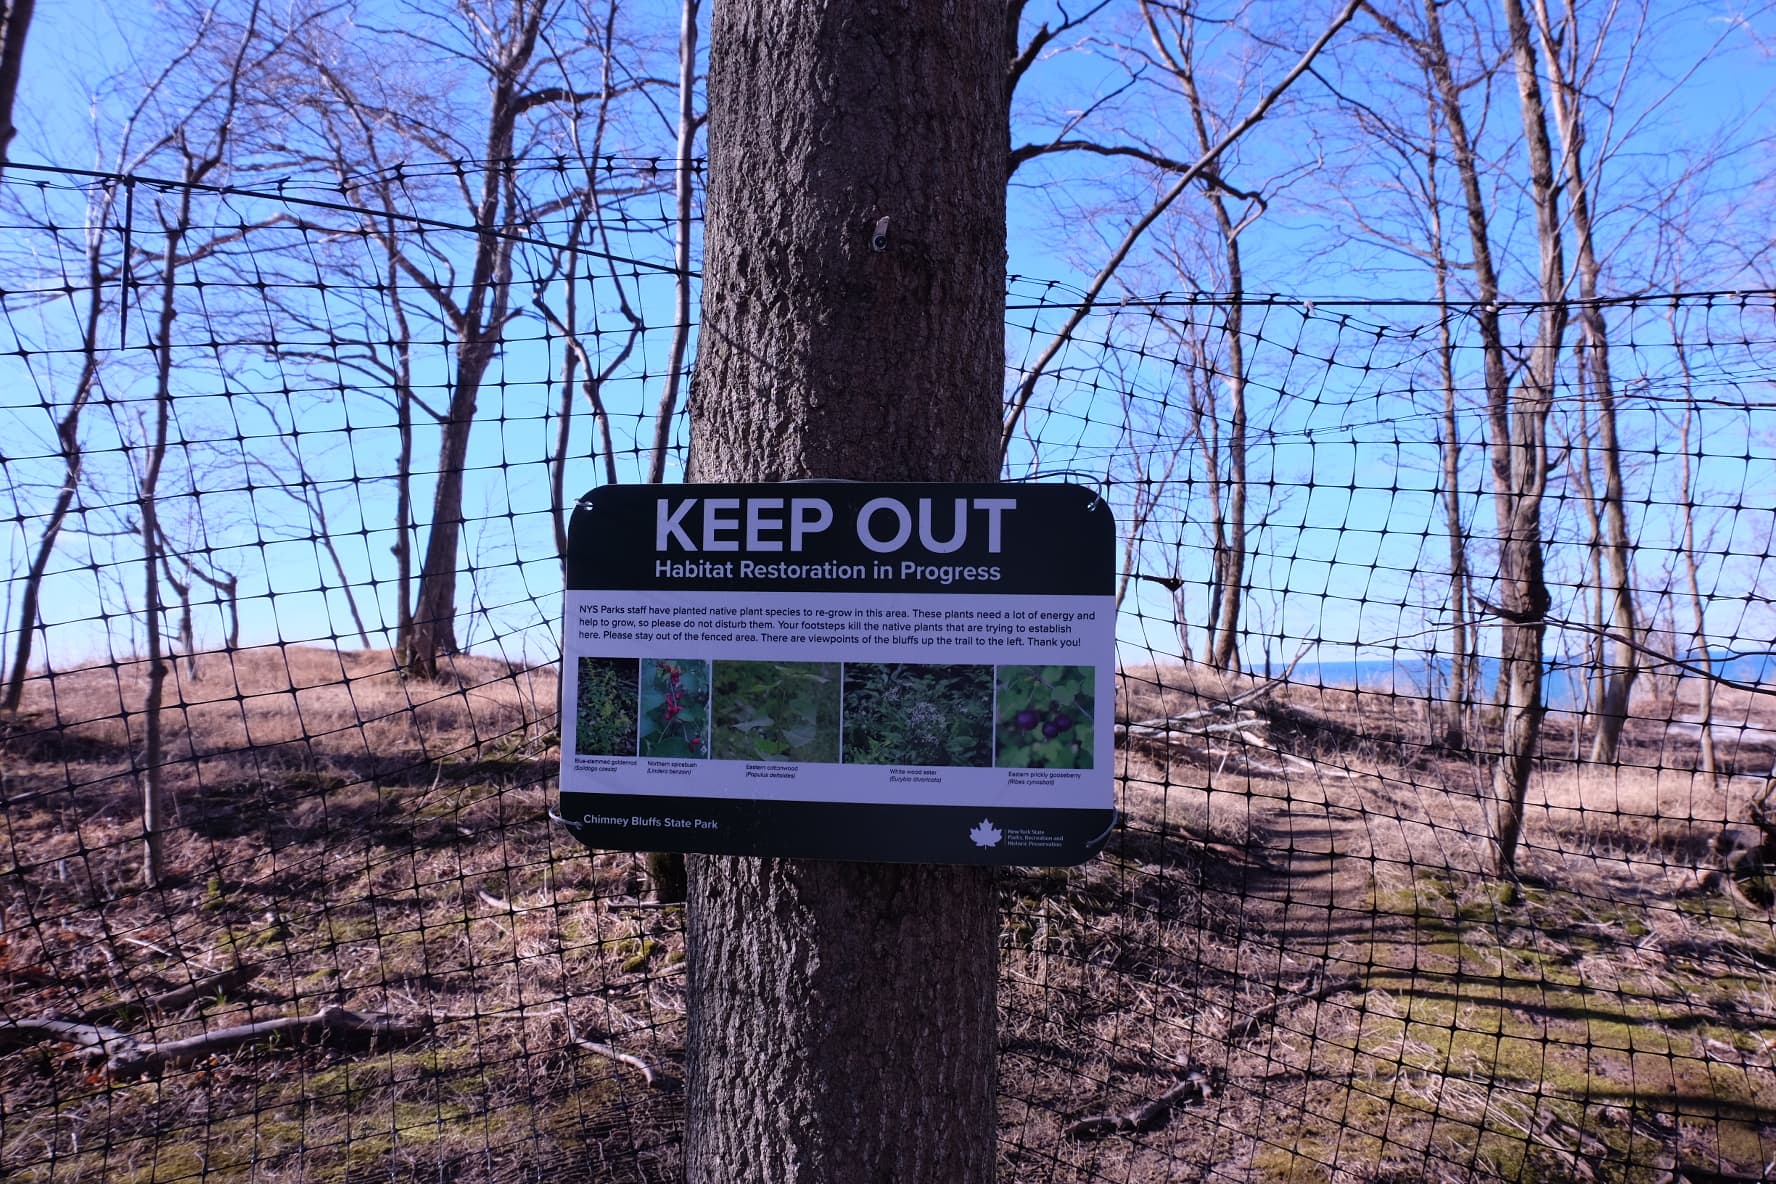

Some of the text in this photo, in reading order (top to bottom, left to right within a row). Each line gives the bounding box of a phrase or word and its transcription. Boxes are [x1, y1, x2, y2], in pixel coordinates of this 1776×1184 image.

[656, 498, 1016, 554] KEEP OUT
[656, 560, 1000, 584] Habitat Restoration in Progress
[579, 605, 598, 614] NYS
[600, 605, 625, 614] Parks
[627, 606, 647, 614] staff
[648, 606, 670, 614] have
[672, 607, 707, 616] planted
[740, 608, 763, 616] plant
[765, 608, 800, 617] species
[803, 608, 813, 616] to
[815, 610, 852, 618] re-grow
[854, 608, 863, 617] in
[866, 608, 883, 618] this
[885, 610, 909, 618] area.
[912, 609, 942, 618] These
[944, 610, 974, 619] plants
[976, 611, 1002, 619] need
[1012, 610, 1025, 619] lot
[1028, 610, 1038, 620] of
[1040, 612, 1074, 622] energy
[1076, 611, 1095, 620] and
[579, 618, 598, 627] help
[611, 620, 636, 628] grow,
[651, 619, 681, 628] please
[683, 620, 695, 628] do
[698, 620, 712, 628] not
[714, 620, 747, 628] disturb
[749, 620, 775, 629] them.
[778, 620, 799, 629] Your
[801, 621, 846, 631] footsteps
[848, 621, 861, 630] kill
[863, 622, 879, 631] the
[882, 622, 911, 631] native
[914, 623, 943, 632] plants
[946, 623, 964, 632] that
[985, 624, 1013, 634] trying
[1016, 624, 1026, 633] to
[1028, 624, 1072, 633] establish
[578, 630, 1082, 648] here. Please stay out of the fenced area. There are viewpoints of the bluffs up the trail to the left. Thank you!
[583, 814, 718, 828] Chimney Bluffs State Park
